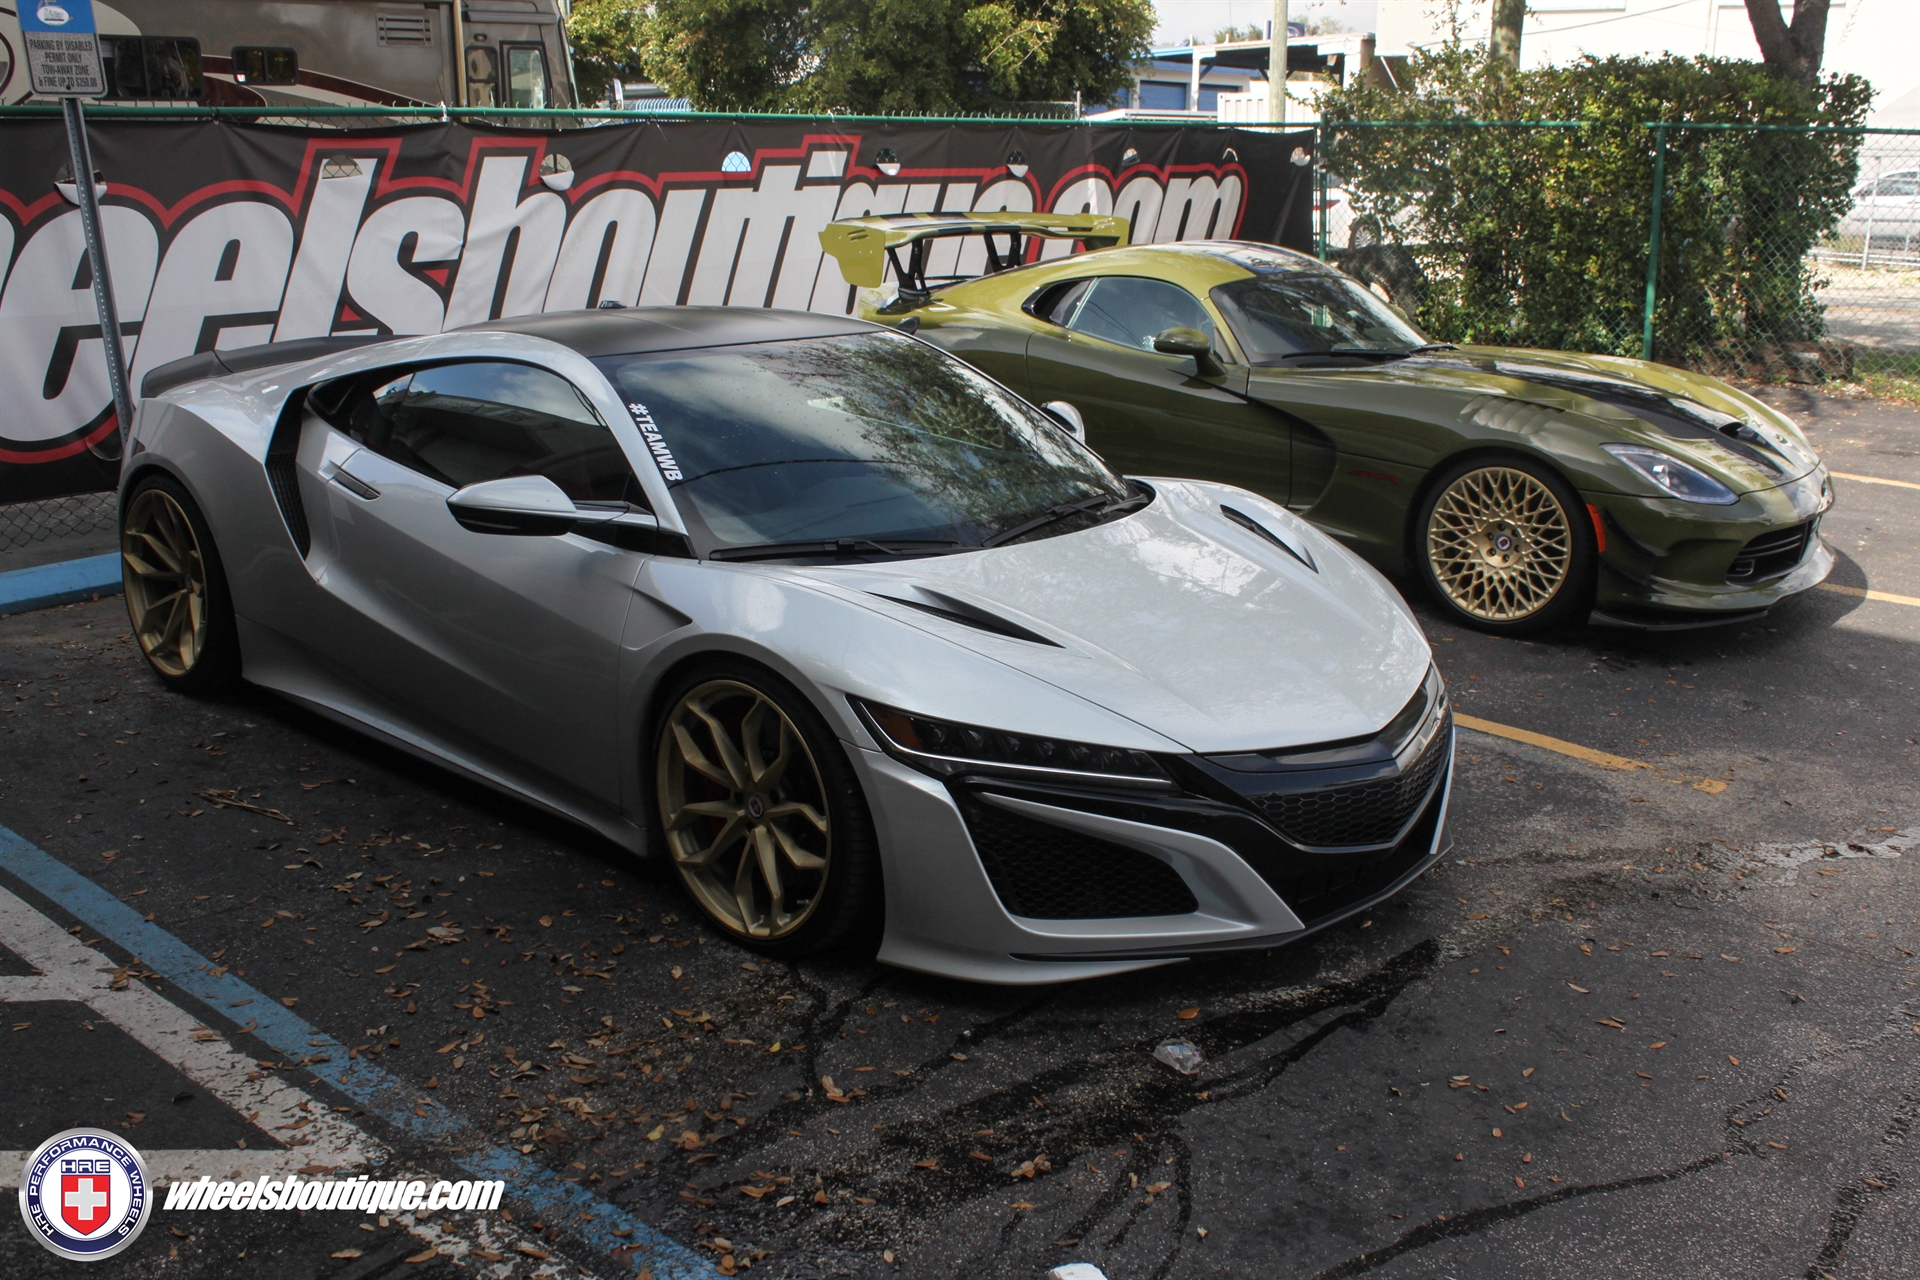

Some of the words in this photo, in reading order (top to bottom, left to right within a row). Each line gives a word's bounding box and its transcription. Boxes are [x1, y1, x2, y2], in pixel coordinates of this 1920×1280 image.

[30, 39, 55, 50] PARKING
[55, 40, 64, 51] BY
[65, 40, 93, 51] DISABLED
[45, 52, 66, 63] PERMIT
[68, 53, 82, 63] ONLY
[41, 64, 74, 75] TOW-AWAY
[75, 65, 90, 75] ZONE
[44, 76, 57, 87] FINE
[58, 77, 66, 87] UP
[66, 77, 75, 87] TO
[75, 77, 98, 87] $250.00
[628, 402, 684, 481] #TEAMWB
